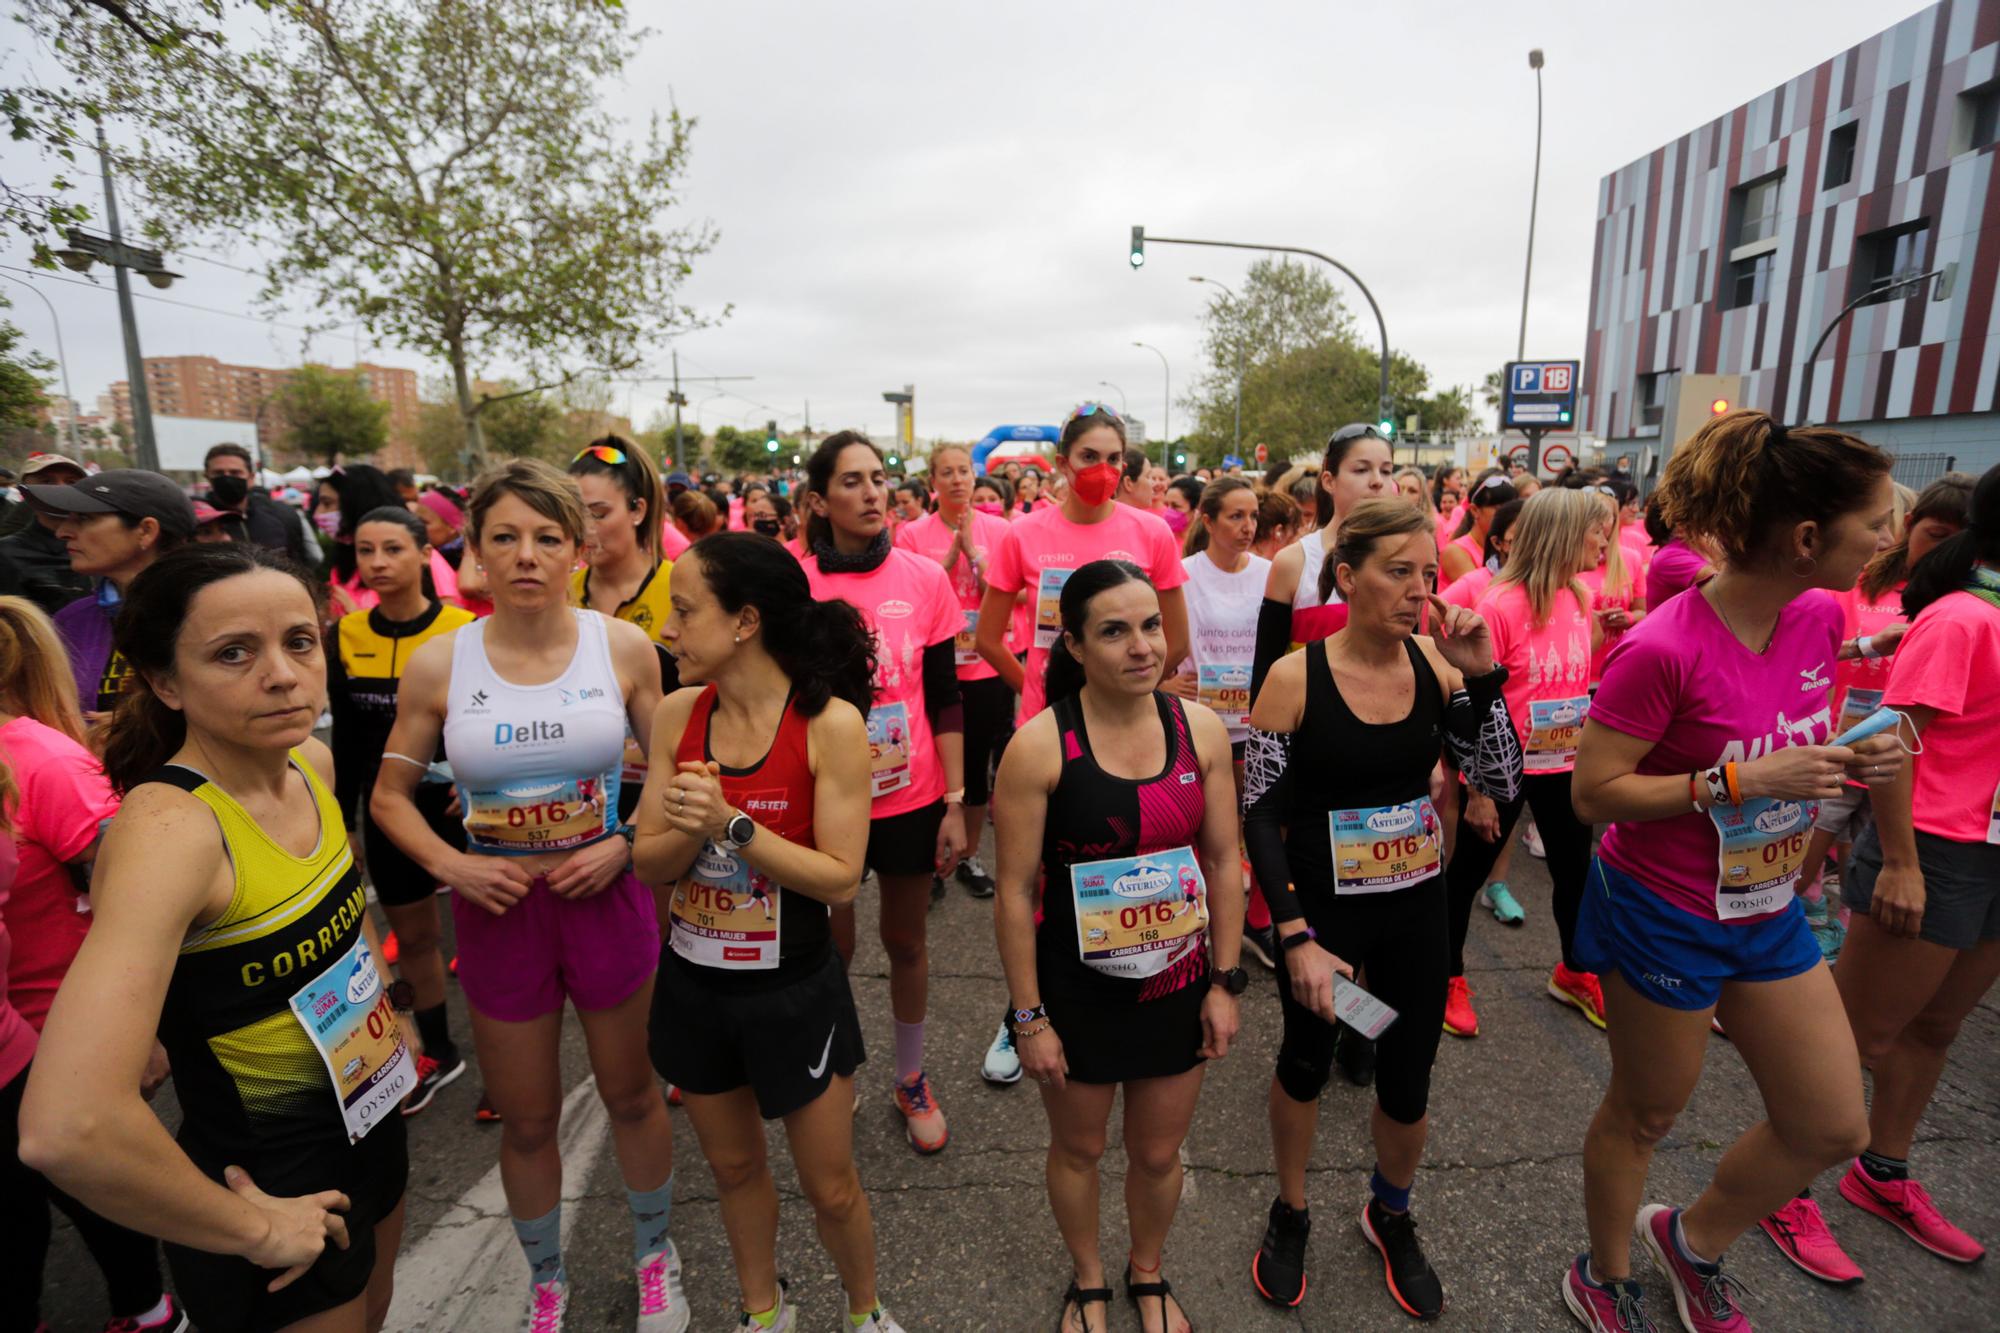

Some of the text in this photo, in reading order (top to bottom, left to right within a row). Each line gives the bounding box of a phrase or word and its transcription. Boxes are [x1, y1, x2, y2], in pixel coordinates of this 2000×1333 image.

[1520, 369, 1535, 389] P
[579, 687, 604, 700] Delta
[1220, 688, 1247, 701] 016
[494, 721, 565, 745] Delta
[1550, 727, 1573, 740] 016
[746, 800, 789, 810] FASTER
[507, 801, 567, 828] 016
[1371, 814, 1415, 829] ASTURIANA
[528, 829, 550, 841] 537
[1372, 835, 1417, 861] 016
[1762, 831, 1804, 865] 016
[1390, 861, 1408, 874] 585
[1782, 863, 1789, 874] 8
[1118, 877, 1170, 893] ASTURIANA
[1362, 876, 1393, 886] CARRERA
[1393, 875, 1402, 883] DE
[1402, 873, 1410, 881] LA
[1749, 879, 1778, 892] CARRERA
[689, 881, 734, 912] 016
[1730, 895, 1773, 910] OYSHO
[697, 912, 715, 926] 701
[1120, 900, 1173, 929] 016
[698, 928, 709, 937] DE
[709, 930, 718, 938] LA
[720, 931, 747, 940] MUJER
[1139, 929, 1159, 941] 168
[1110, 946, 1141, 958] CARRERA
[1143, 943, 1152, 952] DE
[1154, 942, 1163, 950] LA
[315, 995, 338, 1018] SUMA
[367, 990, 397, 1041] 01
[371, 1052, 401, 1084] CARRERA
[360, 1074, 405, 1120] OYSHO
